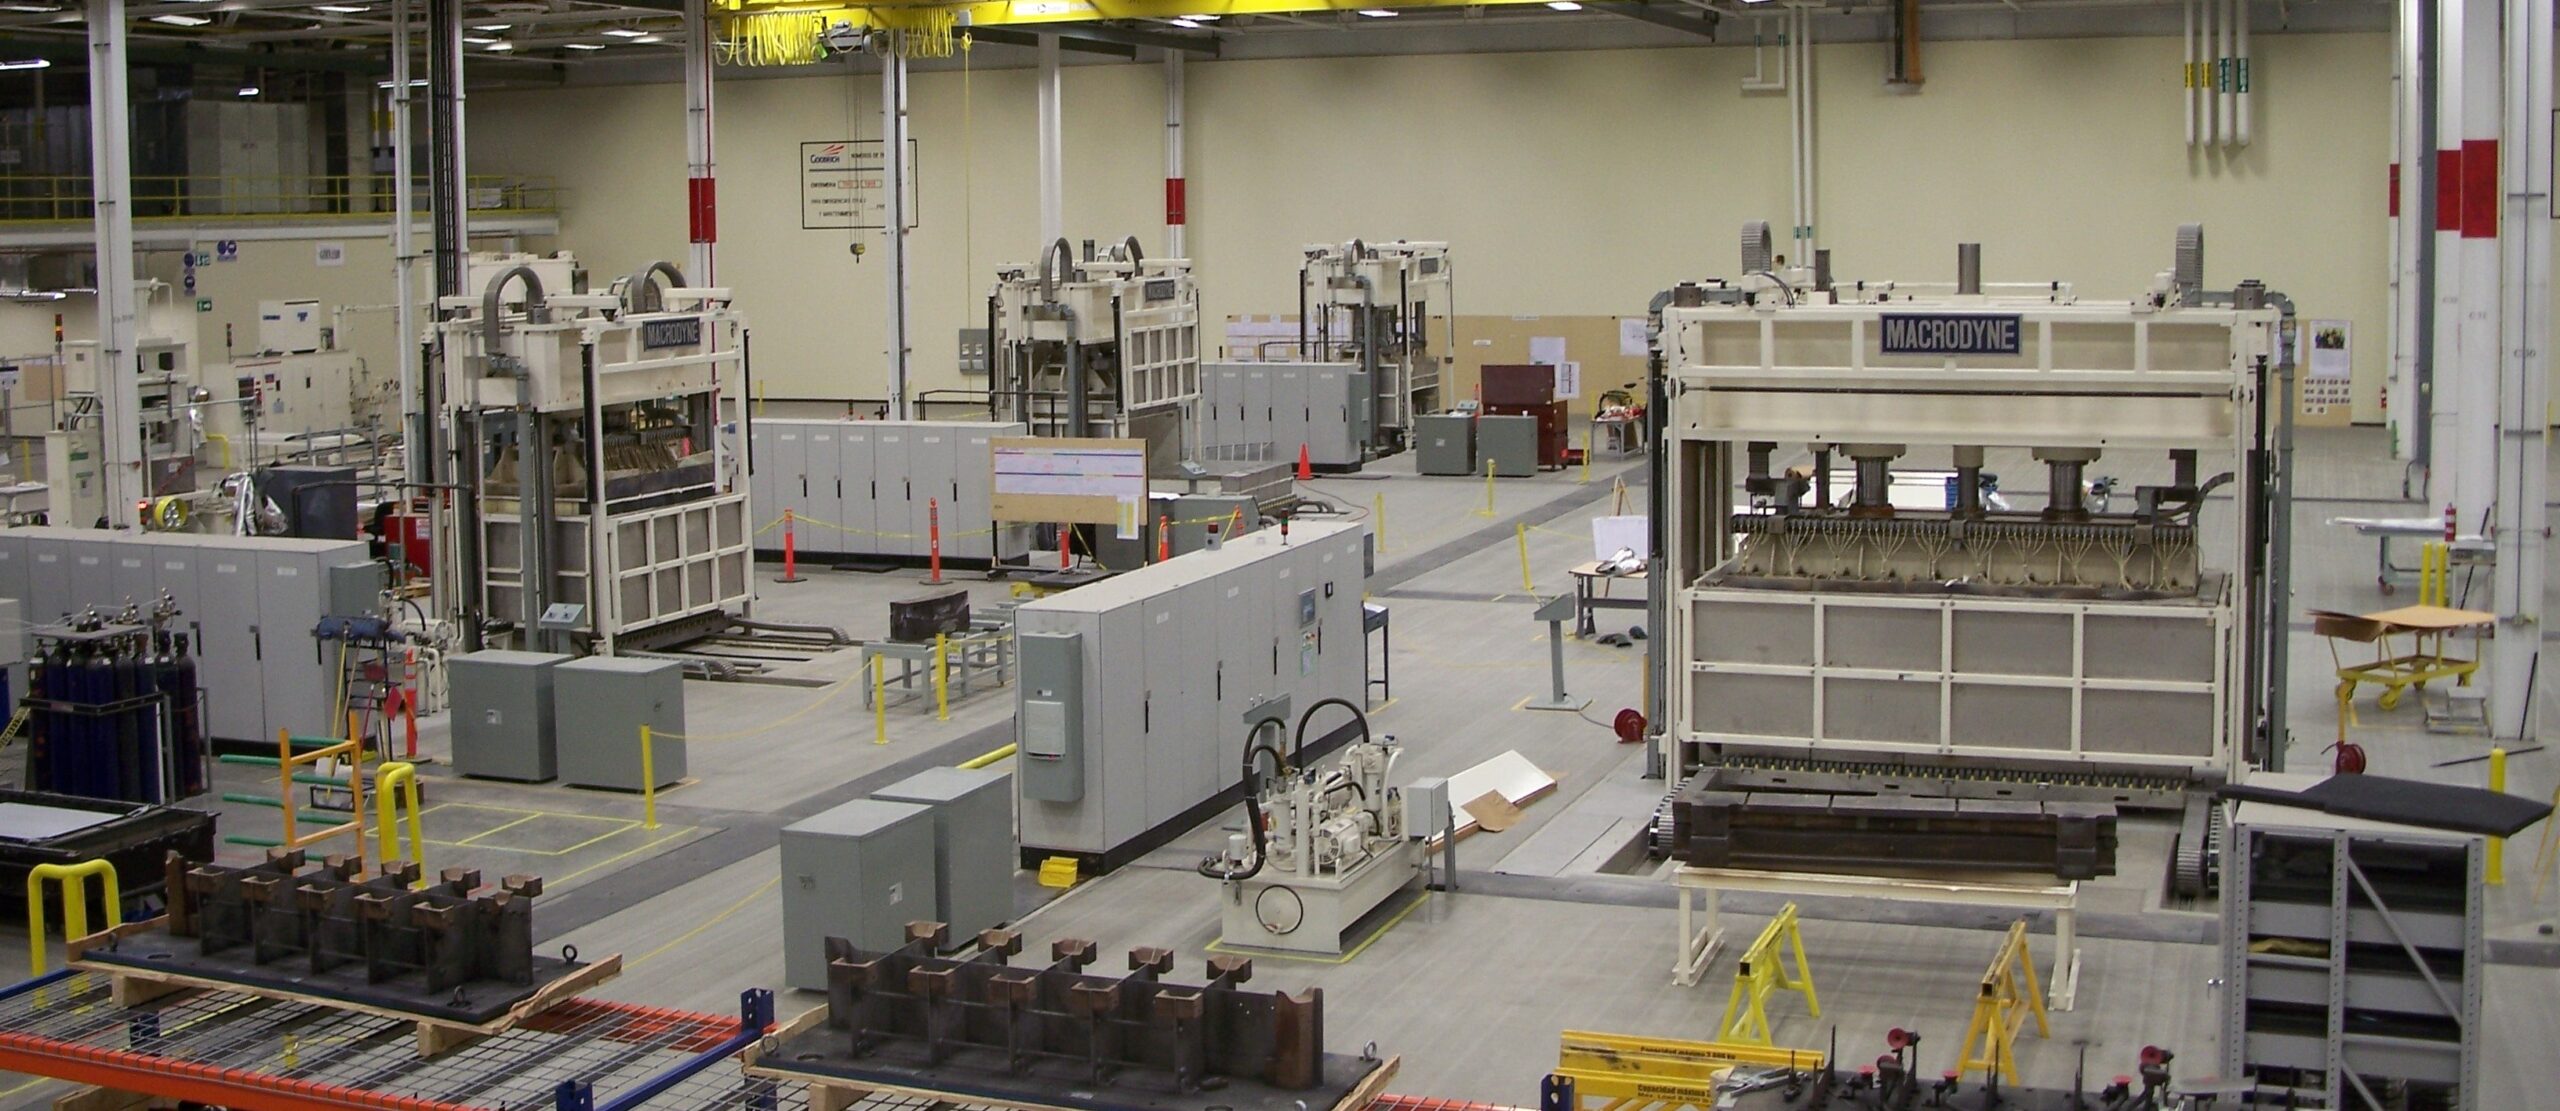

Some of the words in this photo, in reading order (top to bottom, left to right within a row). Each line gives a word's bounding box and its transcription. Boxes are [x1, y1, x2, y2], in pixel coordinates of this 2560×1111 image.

[647, 321, 698, 345] MACRODYNE
[1886, 319, 2015, 350] MACRODYNE
[1637, 1084, 1676, 1094] Capacidad
